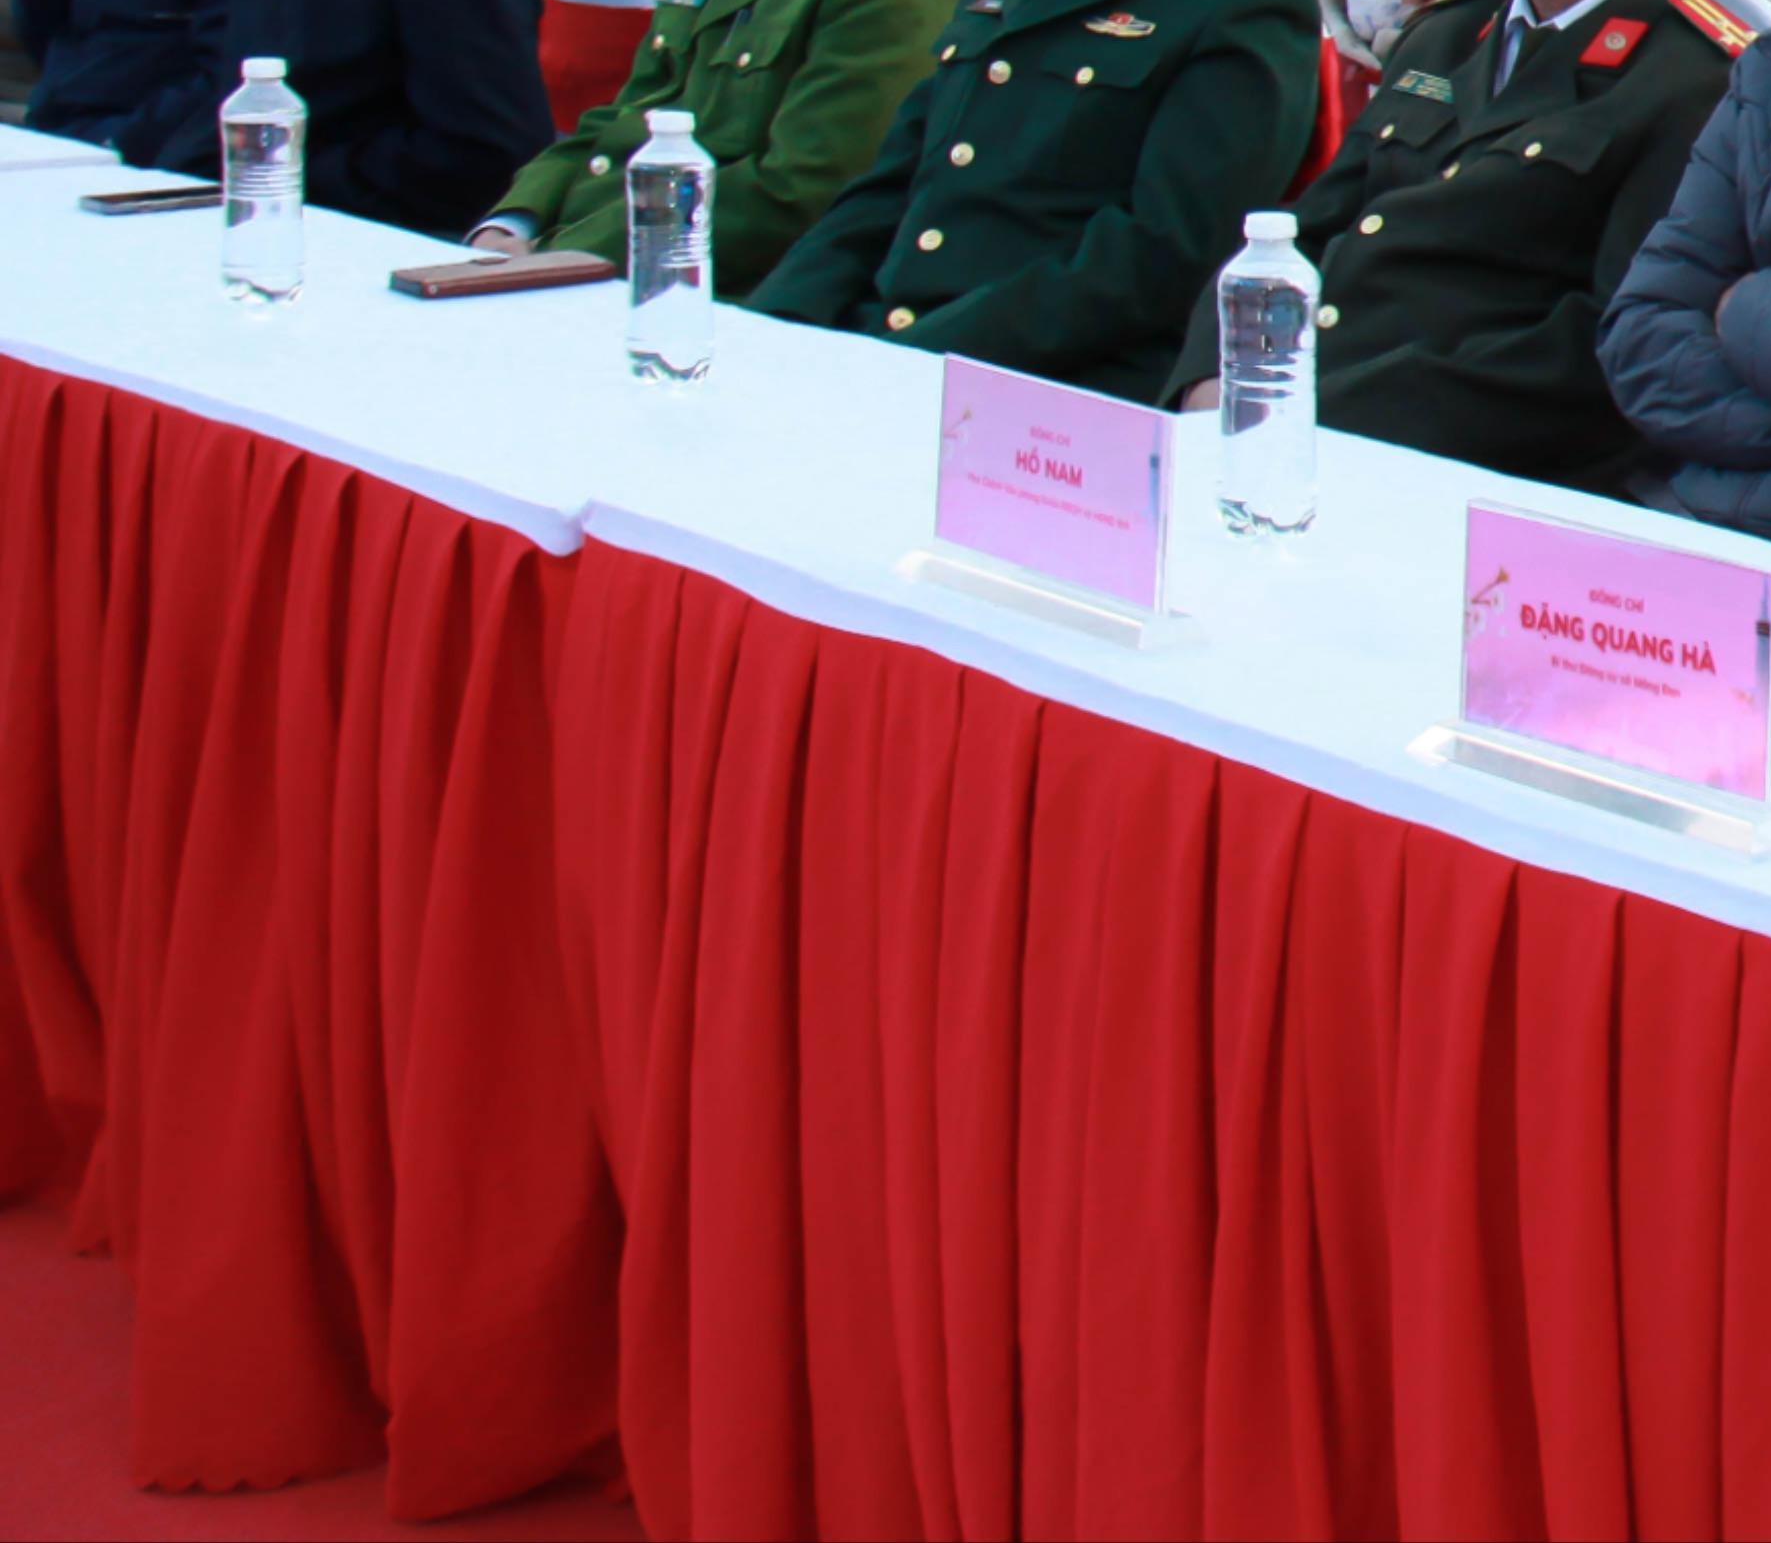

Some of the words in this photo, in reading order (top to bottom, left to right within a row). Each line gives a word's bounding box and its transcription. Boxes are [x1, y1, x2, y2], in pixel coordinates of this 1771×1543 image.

[1044, 457, 1083, 489] NAM
[1519, 602, 1585, 641] ĐẶNG
[1591, 621, 1674, 665] QUANG
[1681, 640, 1717, 676] HÀ
